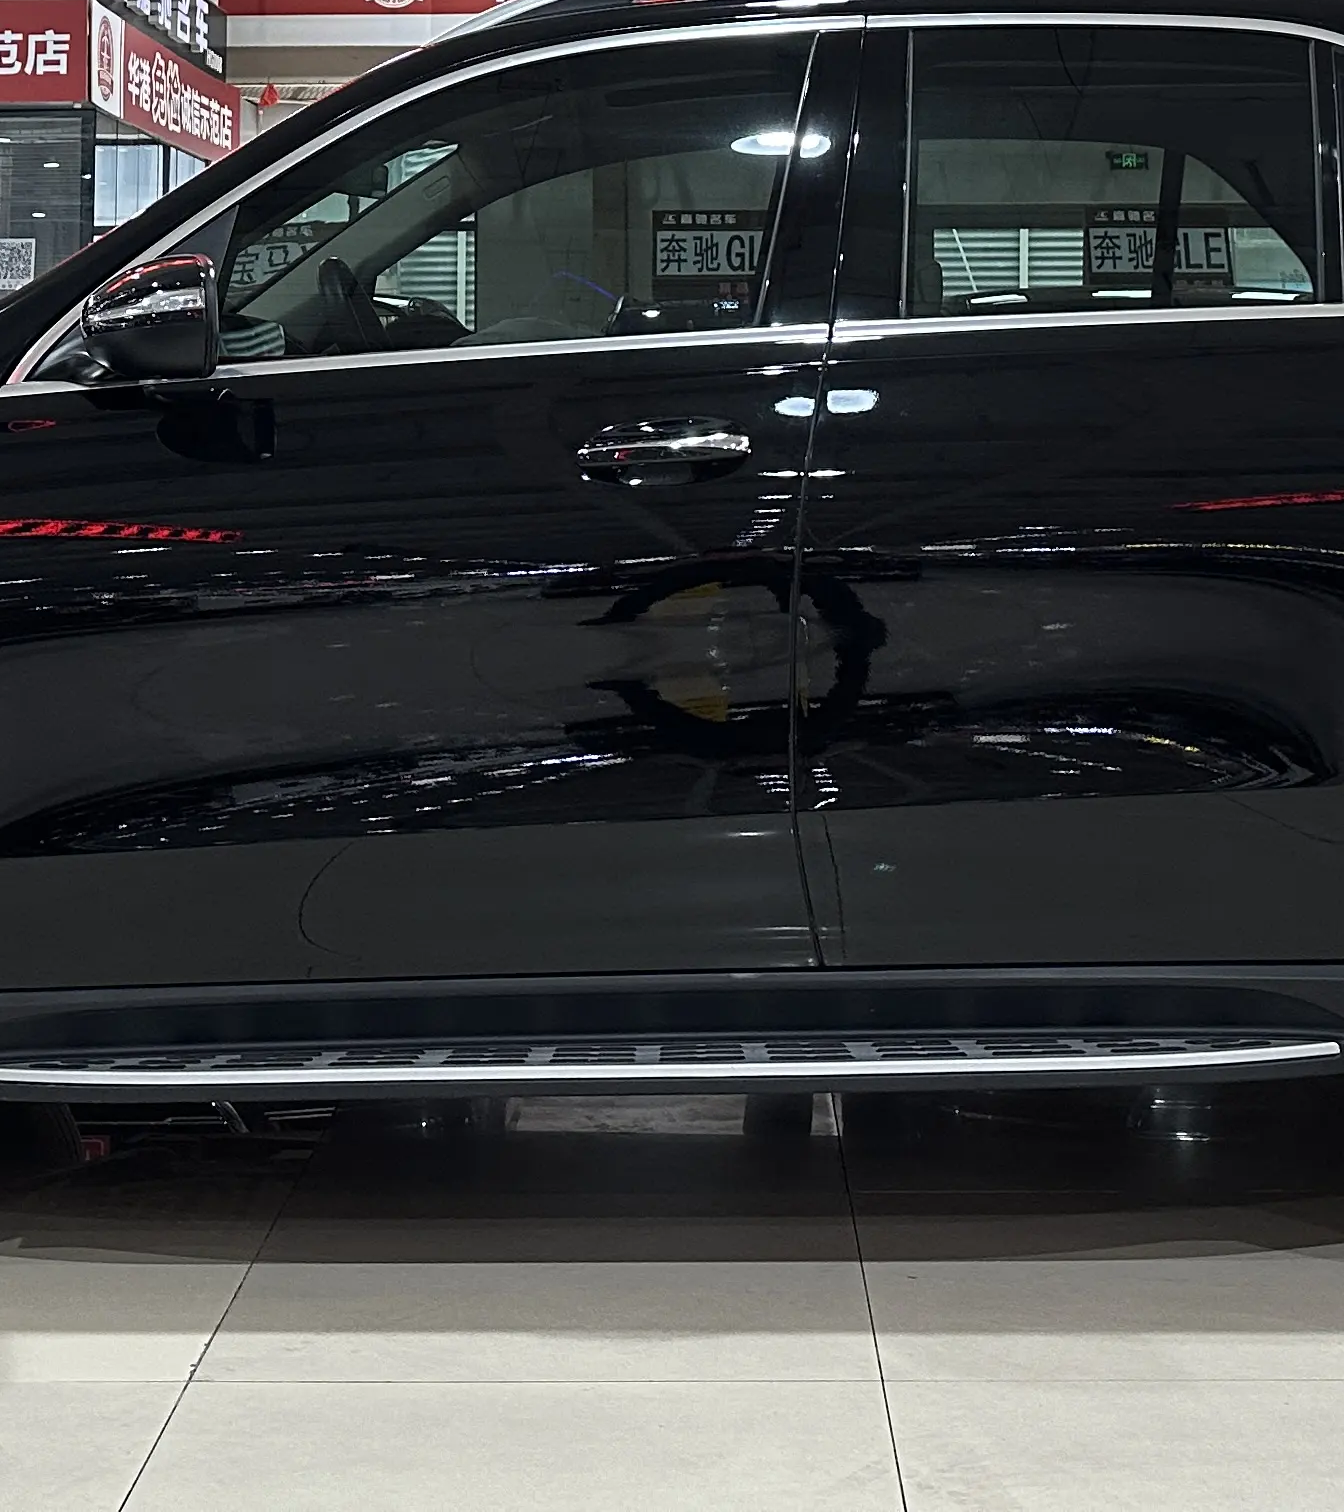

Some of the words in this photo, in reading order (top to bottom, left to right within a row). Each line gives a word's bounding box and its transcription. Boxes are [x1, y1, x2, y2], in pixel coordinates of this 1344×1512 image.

[126, 50, 234, 151] 华港免检诚信示范店
